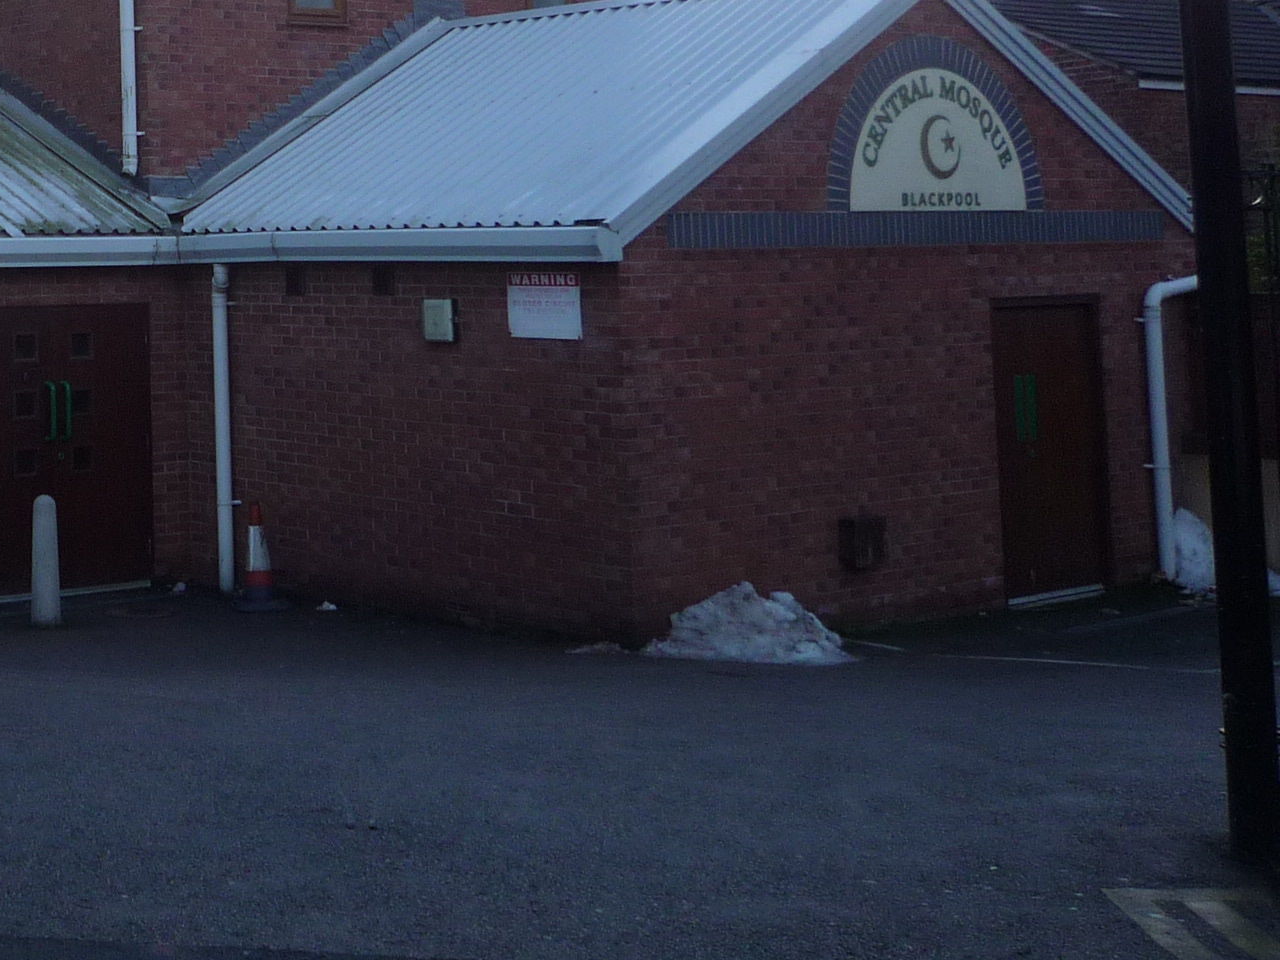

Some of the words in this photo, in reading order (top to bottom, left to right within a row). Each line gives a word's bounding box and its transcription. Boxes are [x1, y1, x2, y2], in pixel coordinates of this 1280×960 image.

[862, 75, 933, 168] CENTRAL
[939, 76, 1013, 170] MOSQUE
[901, 192, 982, 207] BLACKPOOL
[510, 273, 576, 286] WARNING
